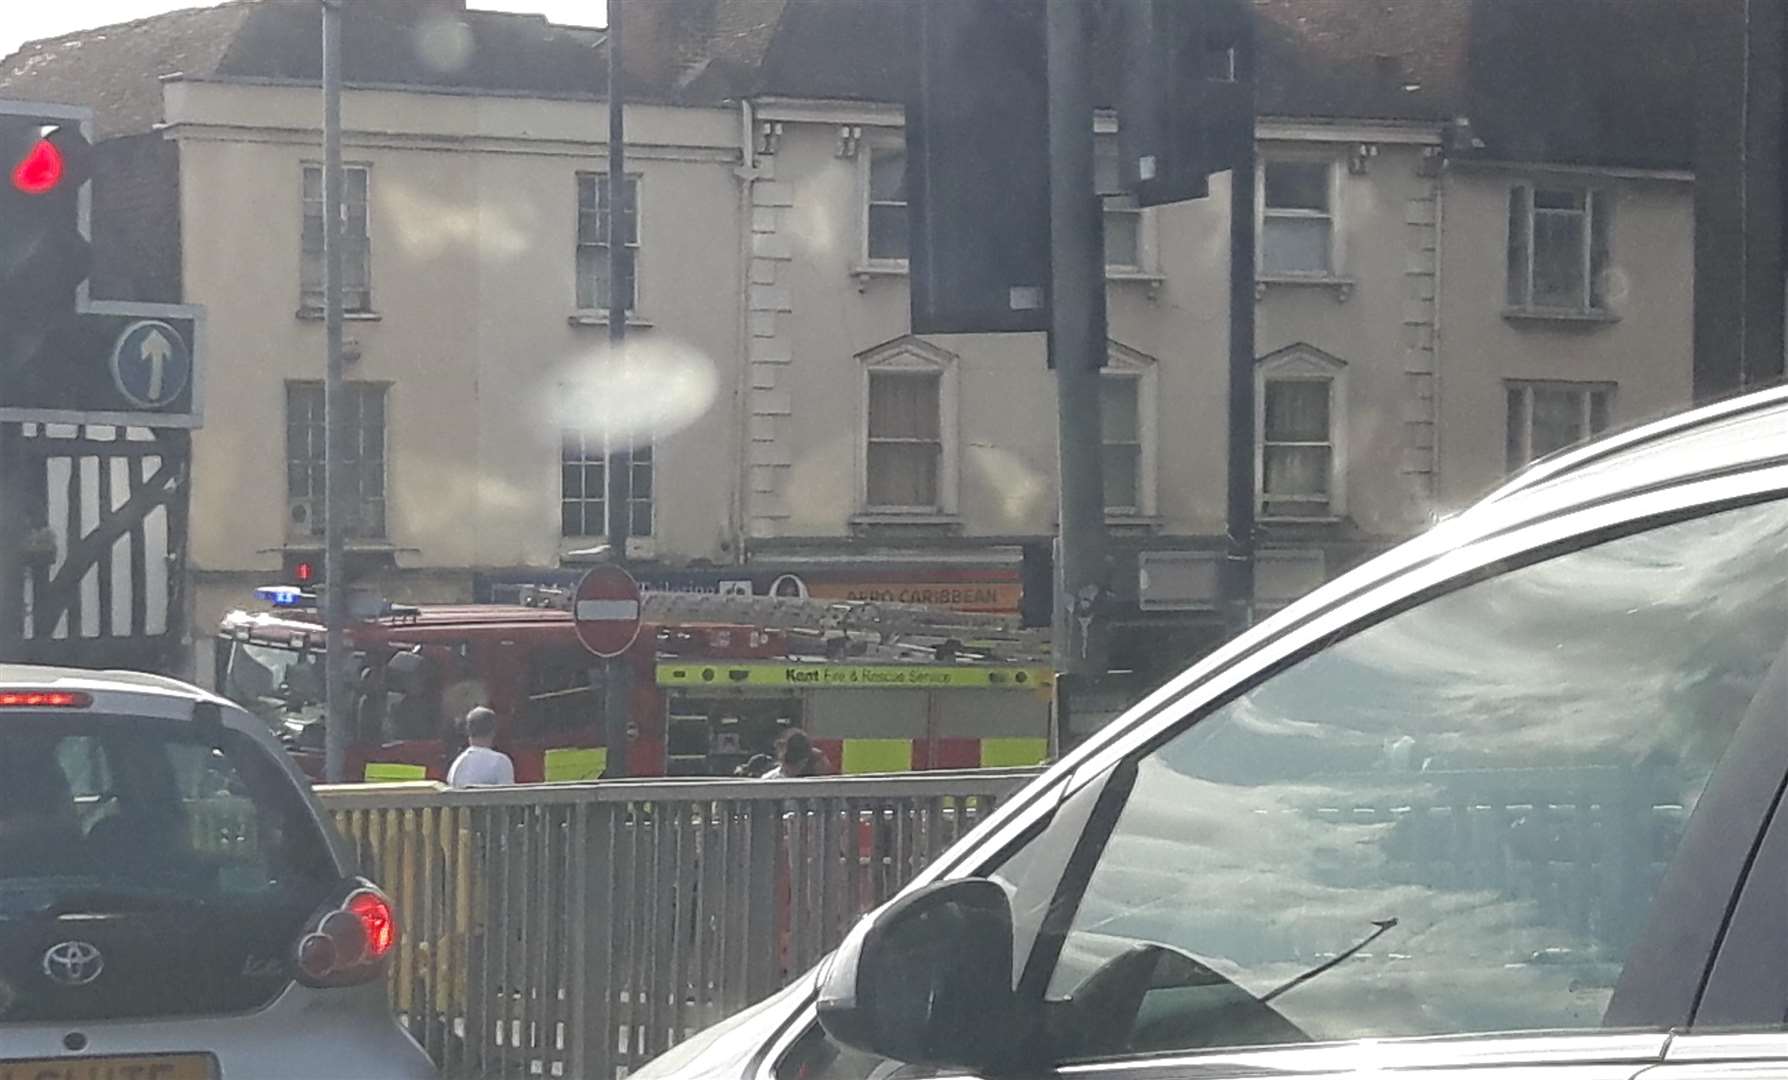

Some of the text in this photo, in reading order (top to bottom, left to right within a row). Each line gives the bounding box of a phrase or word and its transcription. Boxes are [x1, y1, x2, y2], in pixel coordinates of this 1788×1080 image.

[899, 588, 998, 604] CARIBBEAN
[785, 668, 951, 683] Kent Fire & Rescue Service
